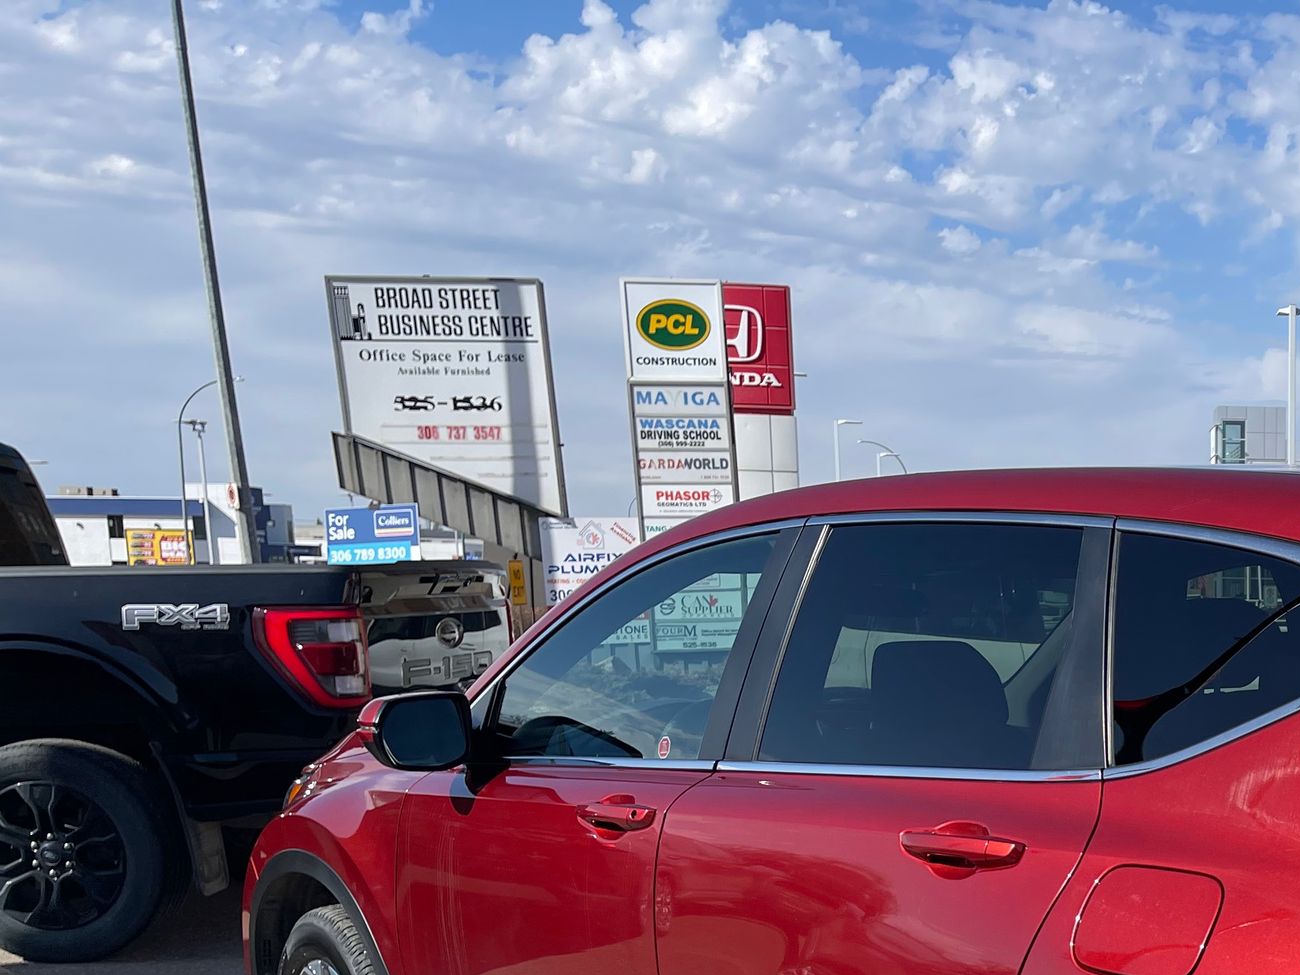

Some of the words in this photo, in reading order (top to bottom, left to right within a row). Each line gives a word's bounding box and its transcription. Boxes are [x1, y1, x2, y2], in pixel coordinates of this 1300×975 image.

[375, 287, 433, 309] BROAD
[439, 288, 501, 310] STREET
[378, 314, 464, 336] BUSINESS
[469, 315, 534, 337] CENTRE
[649, 313, 699, 335] PCL
[359, 349, 406, 363] Office
[412, 349, 452, 364] Space
[458, 350, 482, 363] For
[488, 350, 526, 363] Lease
[636, 356, 717, 367] CONSTRUCTION
[397, 367, 440, 376] Available
[444, 367, 491, 377] Furnished
[640, 419, 720, 429] WASCANA
[446, 425, 467, 441] 737
[473, 425, 502, 441] 3547
[640, 430, 680, 441] DRIVING
[683, 430, 722, 441] SCHOOL
[658, 440, 674, 448] (306)
[638, 458, 729, 470] GARDAWORLD
[655, 490, 710, 501] PHASOR
[328, 513, 350, 526] For
[378, 514, 409, 527] Colliers
[328, 527, 355, 541] Sale
[331, 549, 352, 562] 306
[355, 548, 375, 561] 789
[378, 546, 407, 560] 8300
[548, 564, 606, 574] PLUM
[121, 603, 230, 630] FX4
[402, 650, 493, 687] F-150
